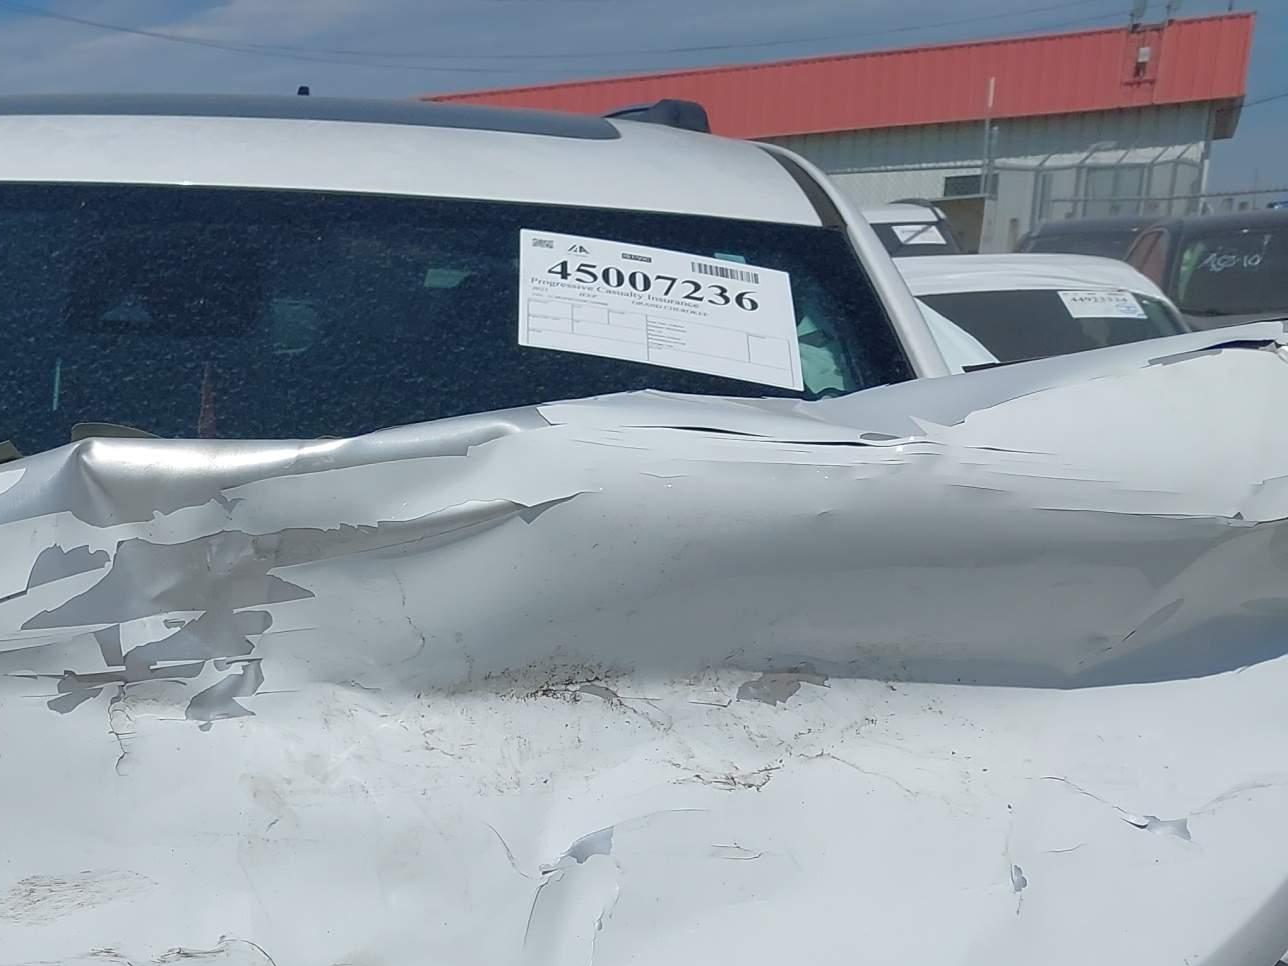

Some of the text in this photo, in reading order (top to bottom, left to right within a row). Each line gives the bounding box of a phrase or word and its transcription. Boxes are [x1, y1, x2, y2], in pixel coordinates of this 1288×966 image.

[530, 276, 594, 293] Progressive
[596, 286, 643, 301] Casualty
[647, 294, 700, 309] Insurance
[547, 259, 759, 312] 45007236
